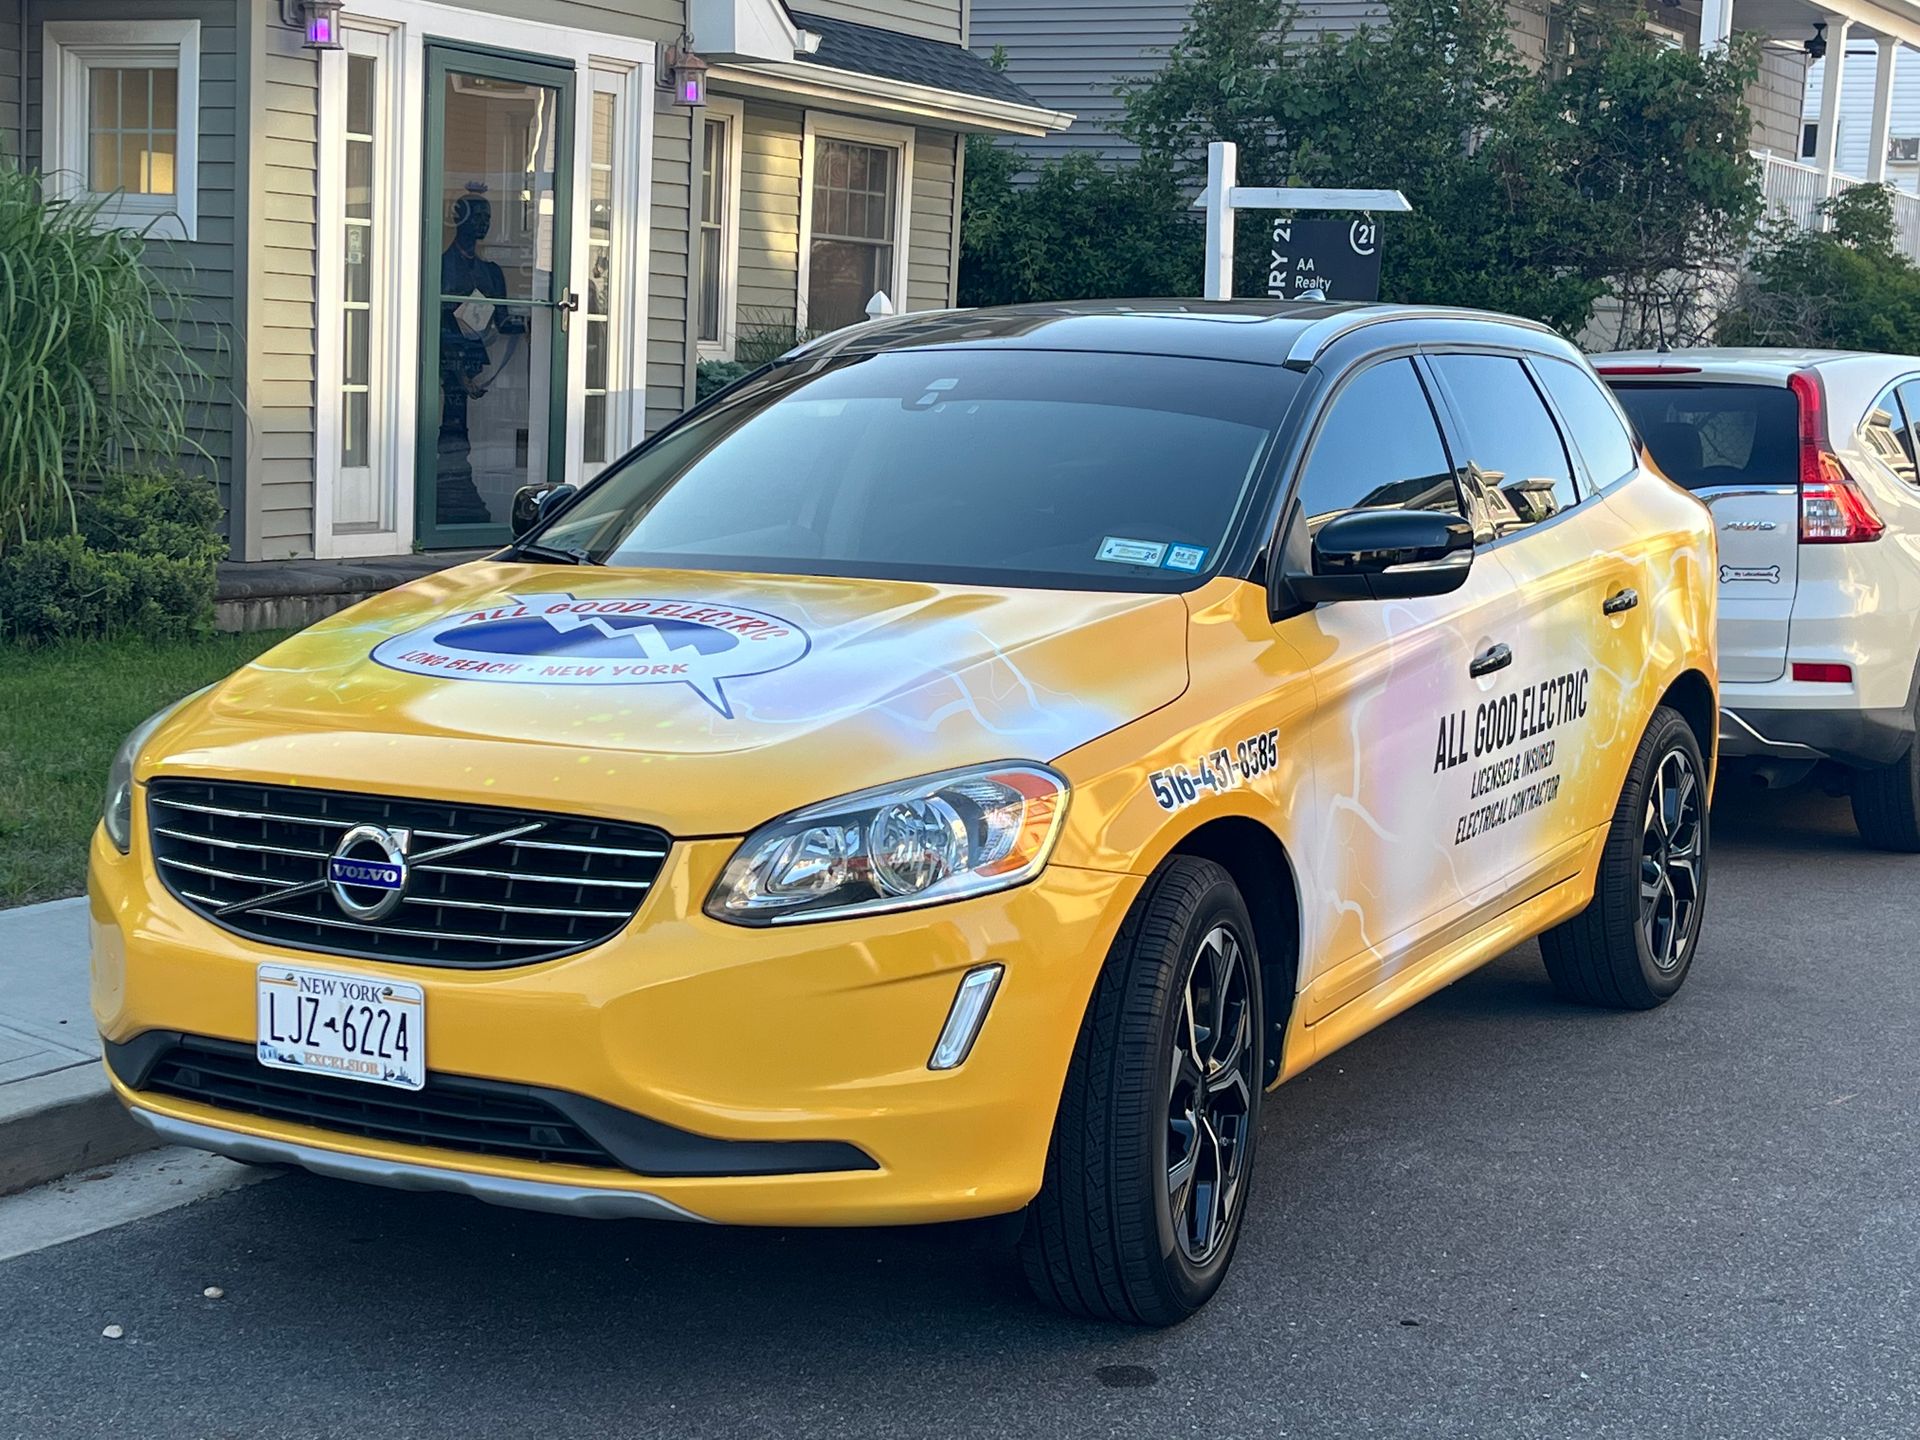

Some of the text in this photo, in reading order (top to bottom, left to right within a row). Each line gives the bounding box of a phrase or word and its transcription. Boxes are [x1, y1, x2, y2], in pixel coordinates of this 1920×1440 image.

[1296, 258, 1314, 271] AA
[1295, 276, 1332, 292] Realty
[1721, 521, 1776, 531] AWD
[460, 601, 790, 641] ALL GOOD ELECTRIC
[397, 650, 689, 676] LONG BEACH NEW YORK
[1433, 710, 1468, 774] ALL
[1474, 693, 1518, 757] GOOD
[1519, 668, 1589, 740] ELECTRIC
[1148, 729, 1279, 809] 516-431-8585
[1471, 740, 1555, 800] LICENSED & INSURED
[1454, 774, 1560, 846] ELECTRICAL CONTRACTOR
[333, 863, 398, 883] VOLVO
[300, 976, 382, 1004] NEW YORK
[303, 1052, 380, 1076] EXCELSIOR
